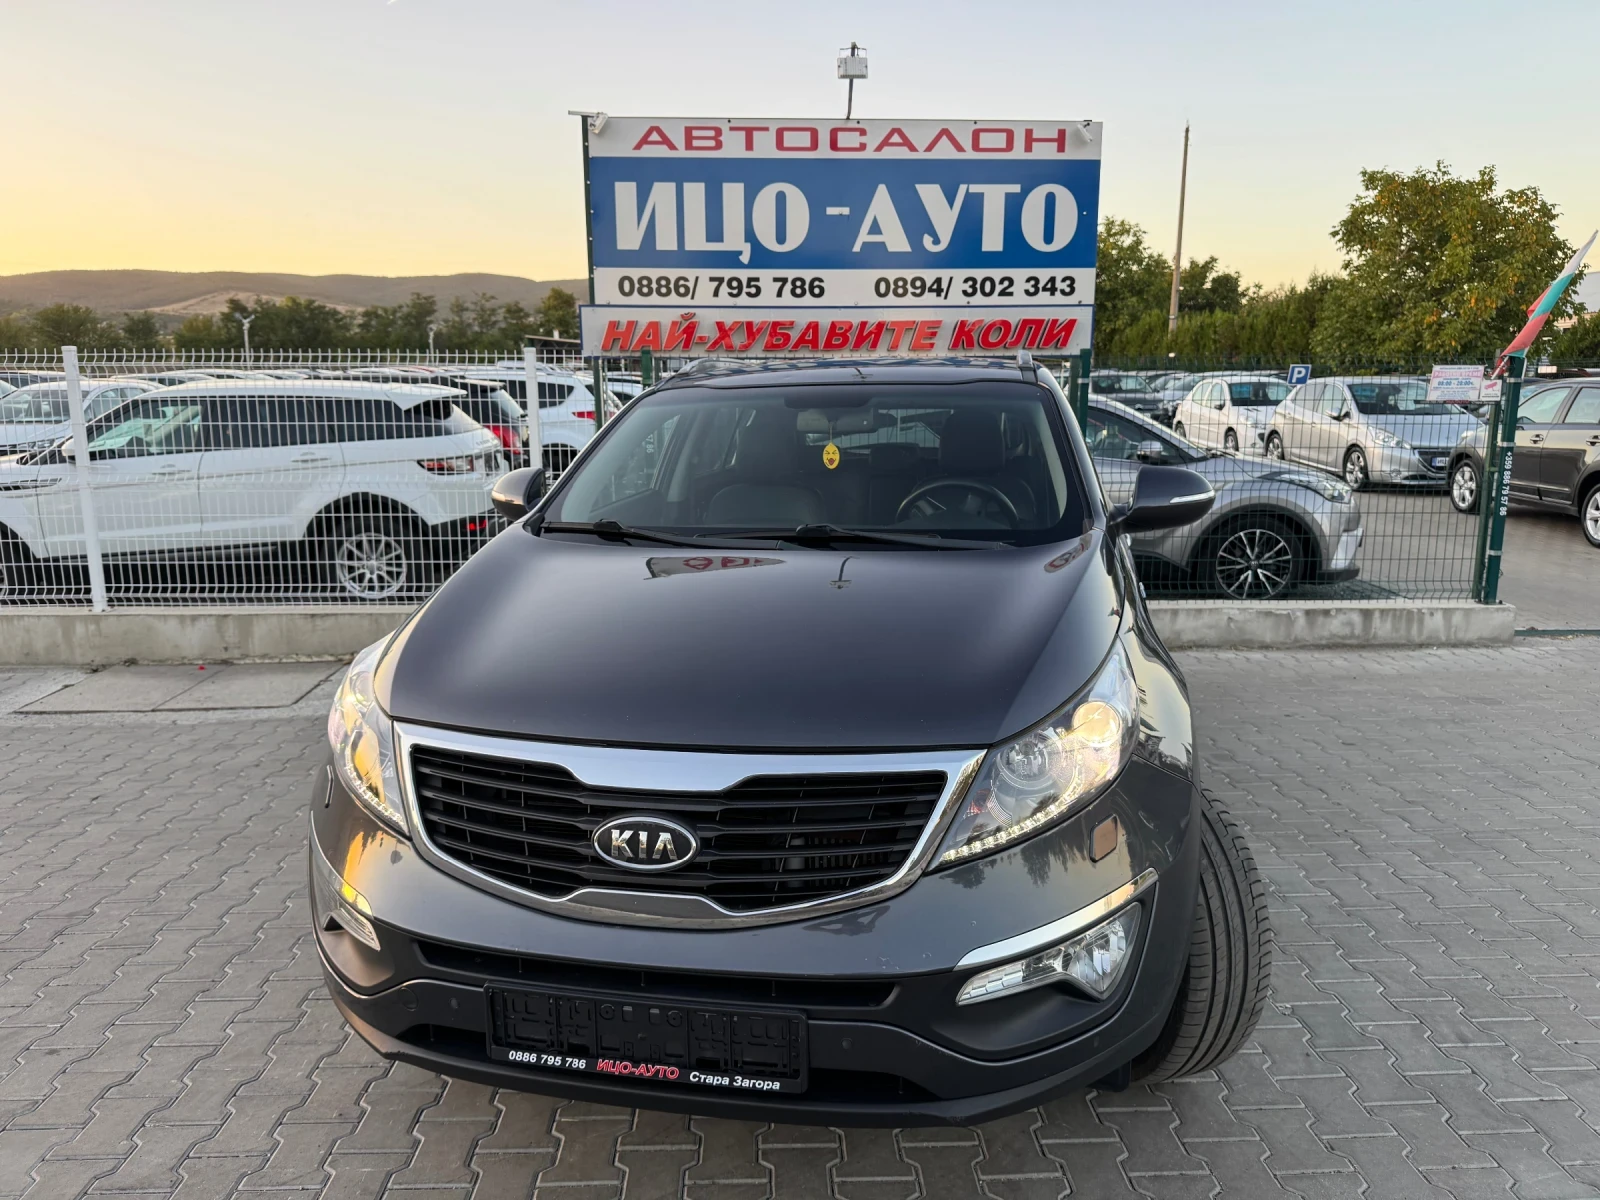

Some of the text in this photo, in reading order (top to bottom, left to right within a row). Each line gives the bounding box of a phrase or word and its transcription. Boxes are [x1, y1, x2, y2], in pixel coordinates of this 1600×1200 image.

[634, 126, 1066, 153] АВТОСАЛОН
[618, 275, 825, 300] 0886/ 795 786
[874, 275, 1076, 300] 0894/ 302 343
[601, 312, 1078, 352] НАЙ-ХУБАВИТЕ КОЛИ
[1291, 367, 1306, 383] P
[610, 829, 678, 860] KIA
[508, 1050, 537, 1063] 0886
[540, 1054, 563, 1067] 795
[595, 1058, 680, 1080] ИЦО-АУТО
[689, 1071, 730, 1086] Стара
[732, 1075, 781, 1091] Загора
